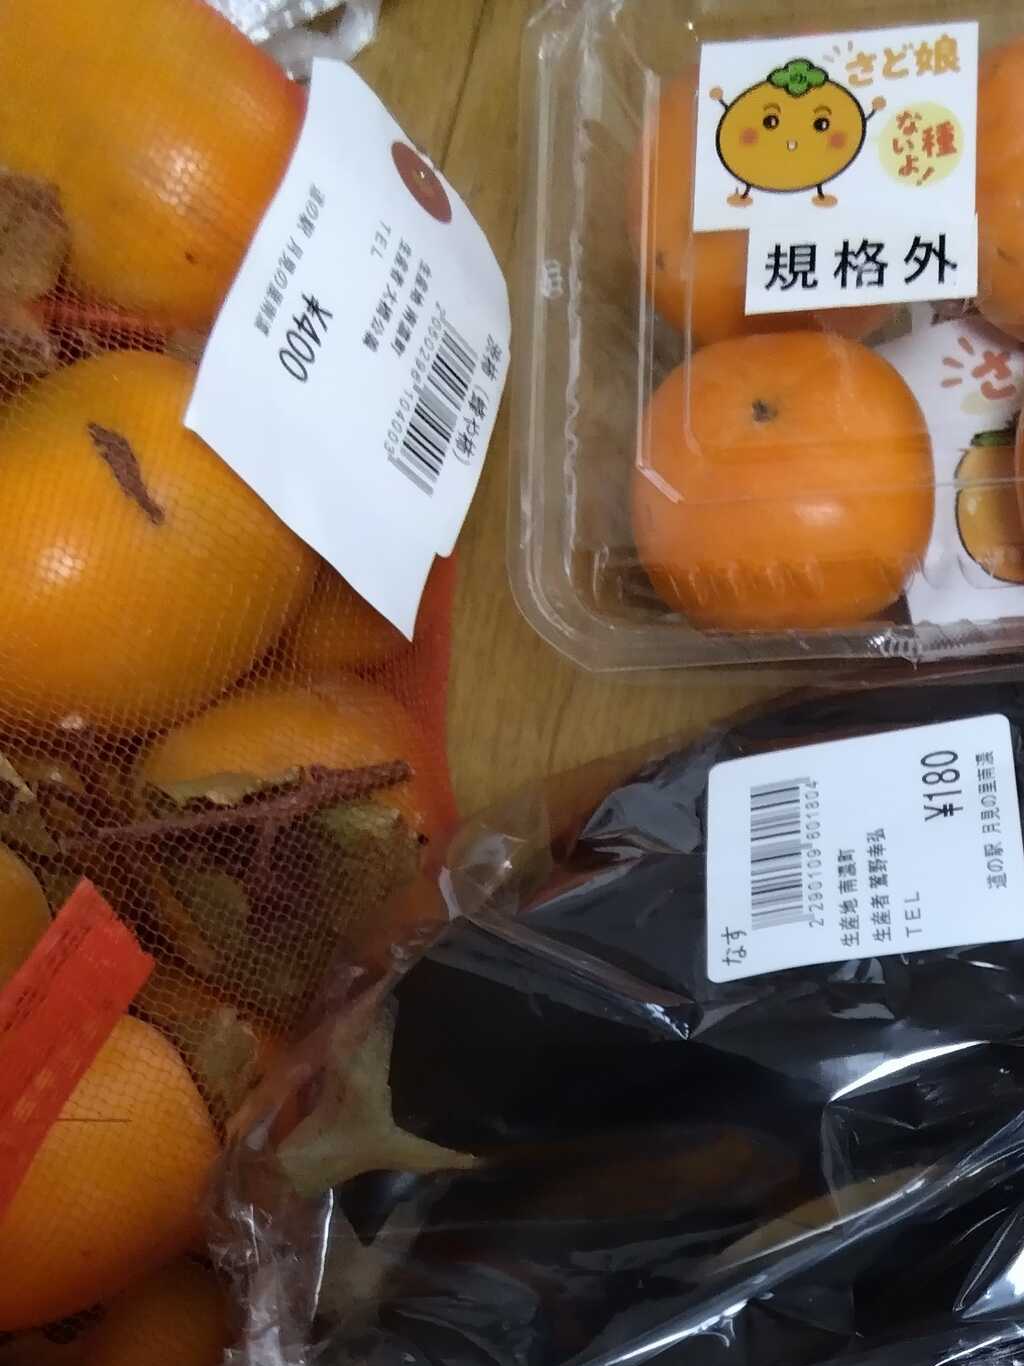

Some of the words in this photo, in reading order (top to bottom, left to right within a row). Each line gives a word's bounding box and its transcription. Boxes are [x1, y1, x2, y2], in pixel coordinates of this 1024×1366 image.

[845, 33, 961, 88] さど娘
[921, 121, 958, 158] 種
[369, 220, 391, 257] TEL
[764, 234, 958, 291] 規格外
[278, 292, 333, 383] ¥400
[920, 750, 963, 822] ¥180
[975, 750, 1002, 834] 月見の里南濃
[837, 849, 859, 895] 南濃町
[984, 844, 1007, 889] 道の駅
[840, 898, 860, 948] 生産地
[871, 894, 892, 943] 生産者
[904, 891, 922, 938] TEL
[721, 926, 747, 966] なす
